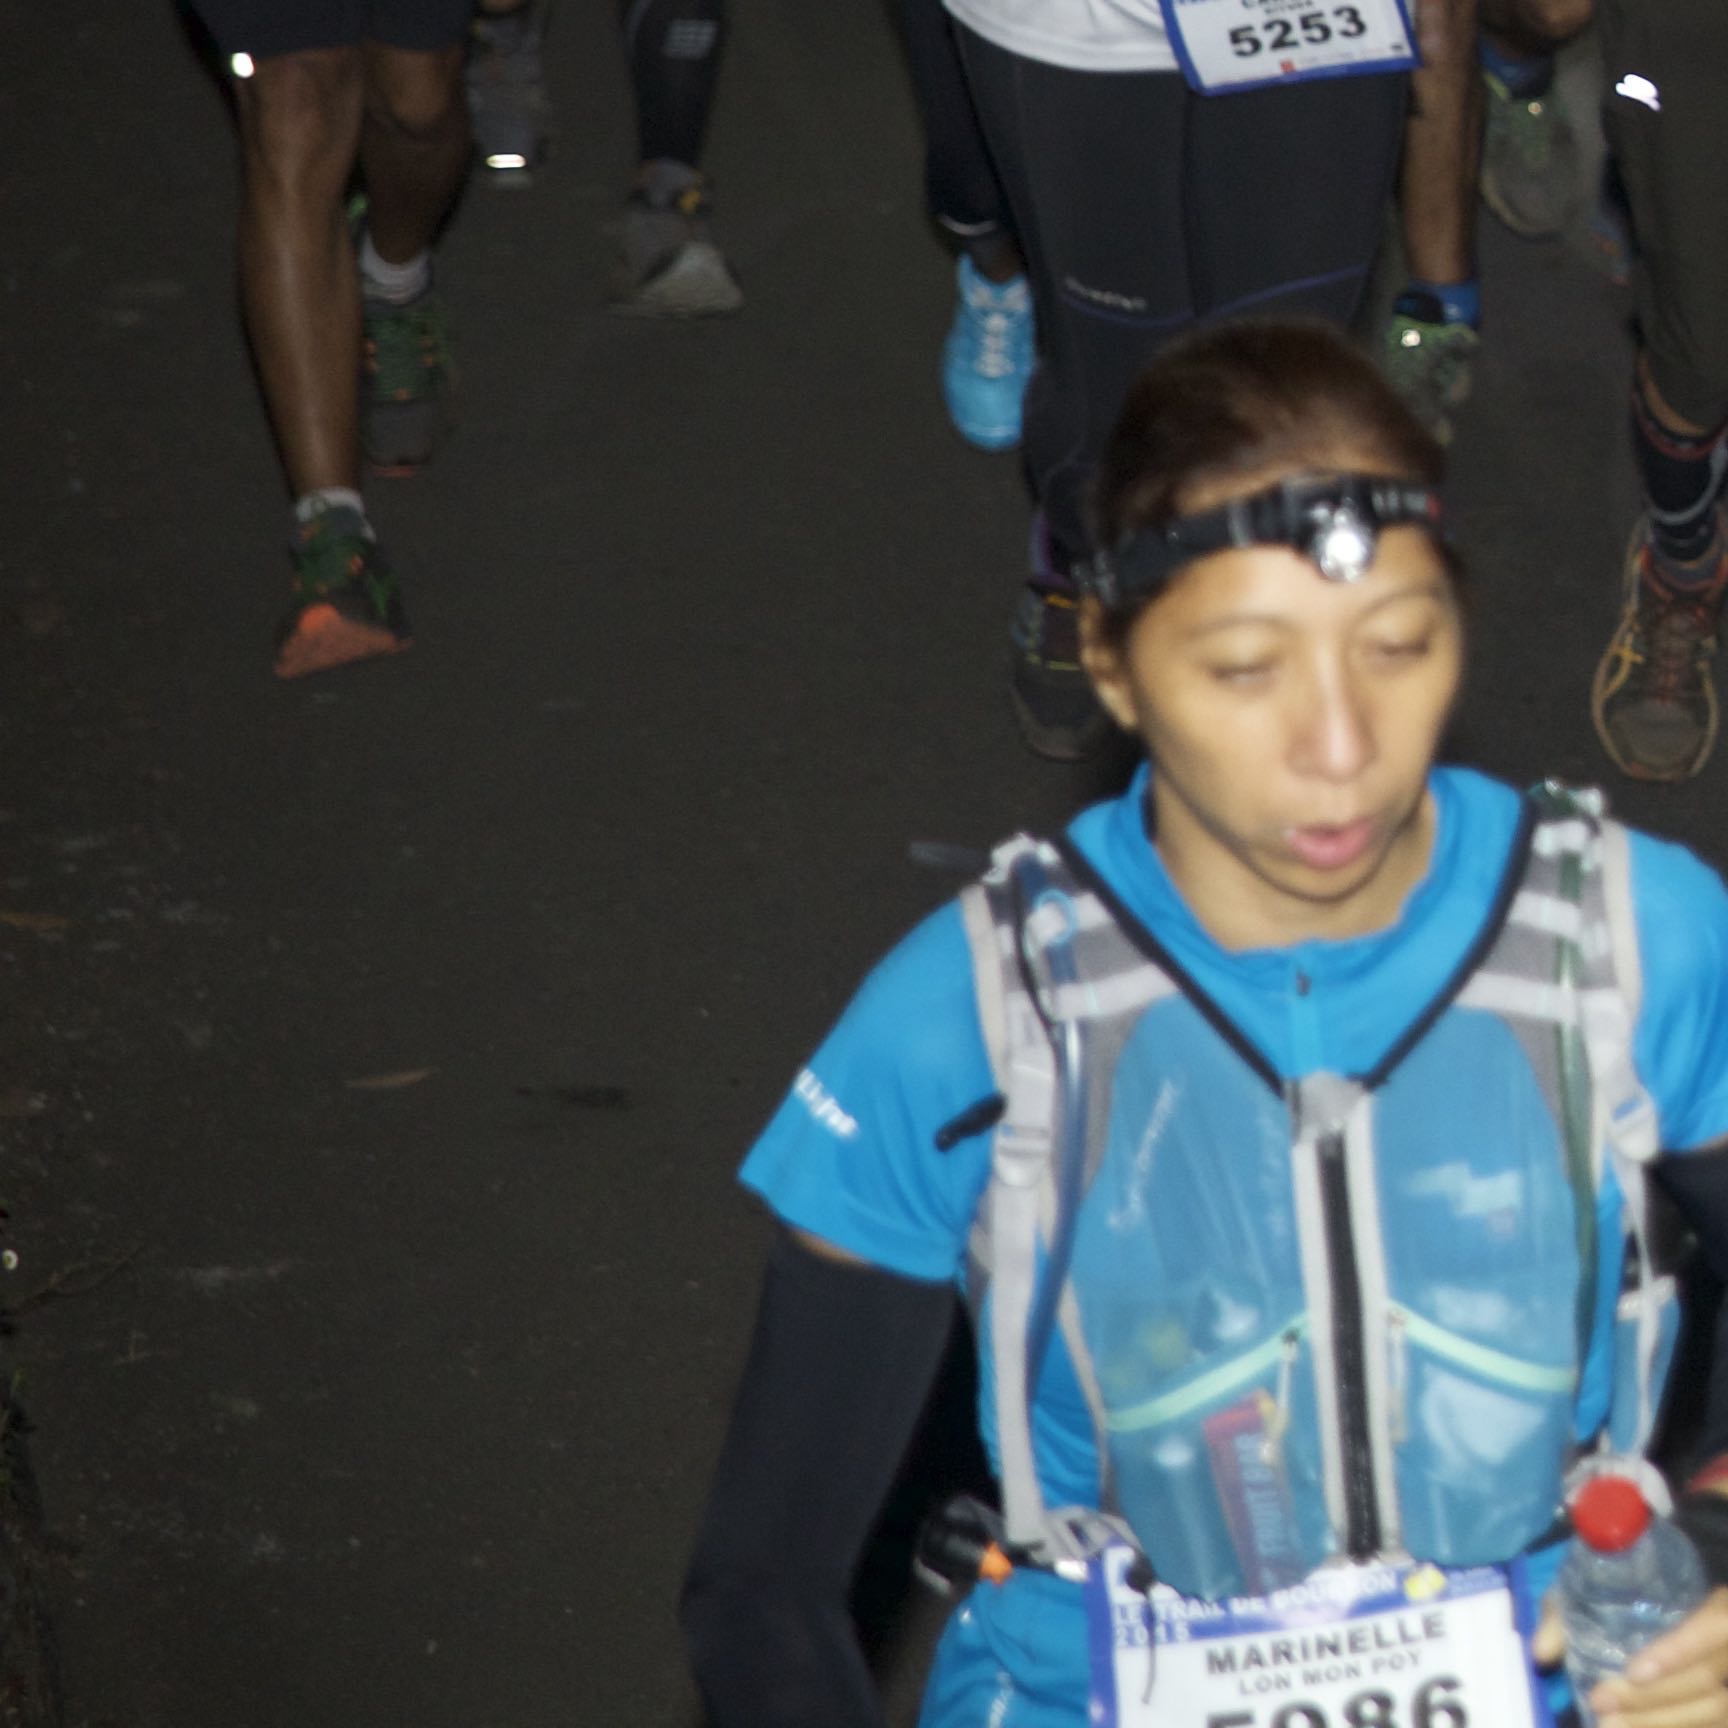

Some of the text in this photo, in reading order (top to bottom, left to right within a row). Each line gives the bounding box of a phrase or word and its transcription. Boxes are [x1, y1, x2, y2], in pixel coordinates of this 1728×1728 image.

[1229, 5, 1367, 58] 5253
[1206, 1610, 1447, 1675] MARINELLE
[1239, 1649, 1423, 1696] LON MON POY
